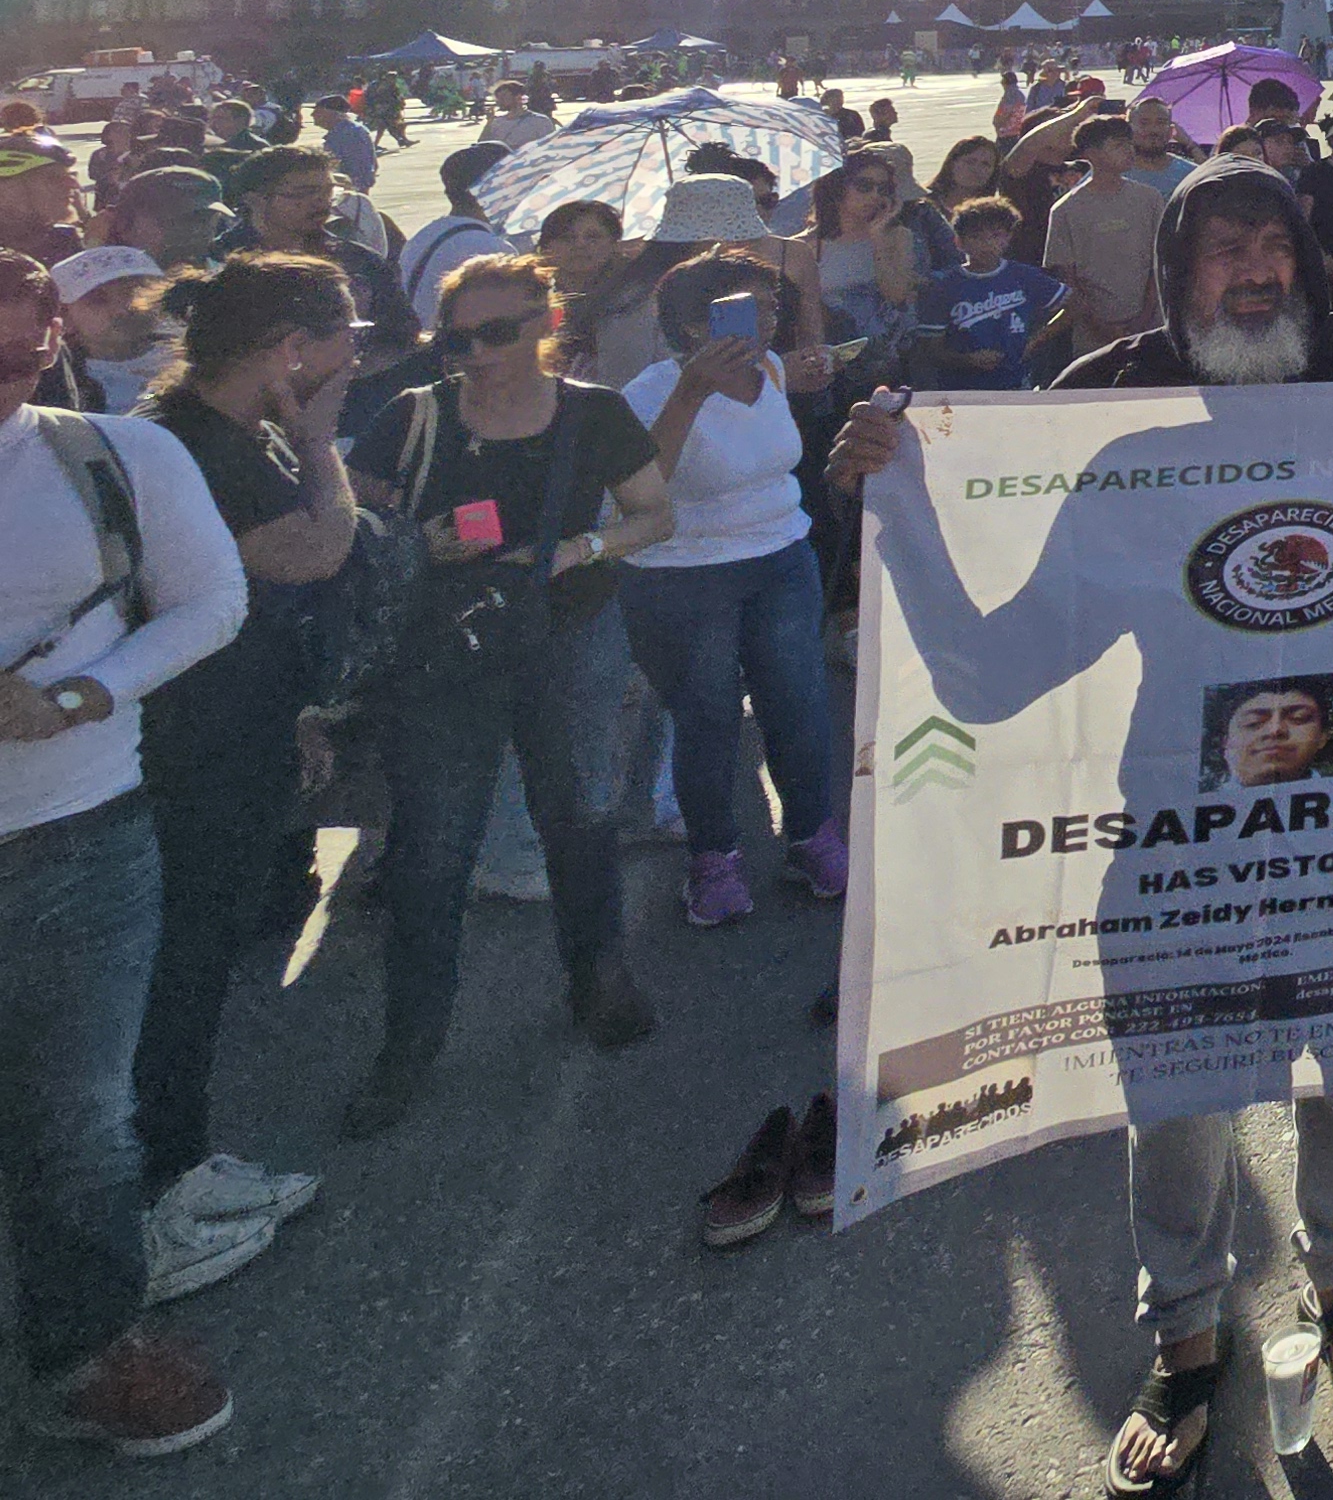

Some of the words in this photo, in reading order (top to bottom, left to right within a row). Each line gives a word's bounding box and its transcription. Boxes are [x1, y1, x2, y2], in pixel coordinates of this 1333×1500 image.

[965, 460, 1296, 500] DESAPARECIDOS
[1199, 580, 1299, 626] NACIONAL
[1138, 866, 1218, 894] HAS
[989, 915, 1153, 949] Abraham
[964, 1032, 1001, 1056] POR
[1007, 1017, 1072, 1040] FAVOR
[965, 1022, 983, 1040] SI
[1226, 1029, 1260, 1050] NO
[1269, 1025, 1299, 1043] TE
[961, 1033, 1065, 1070] CONTACTO
